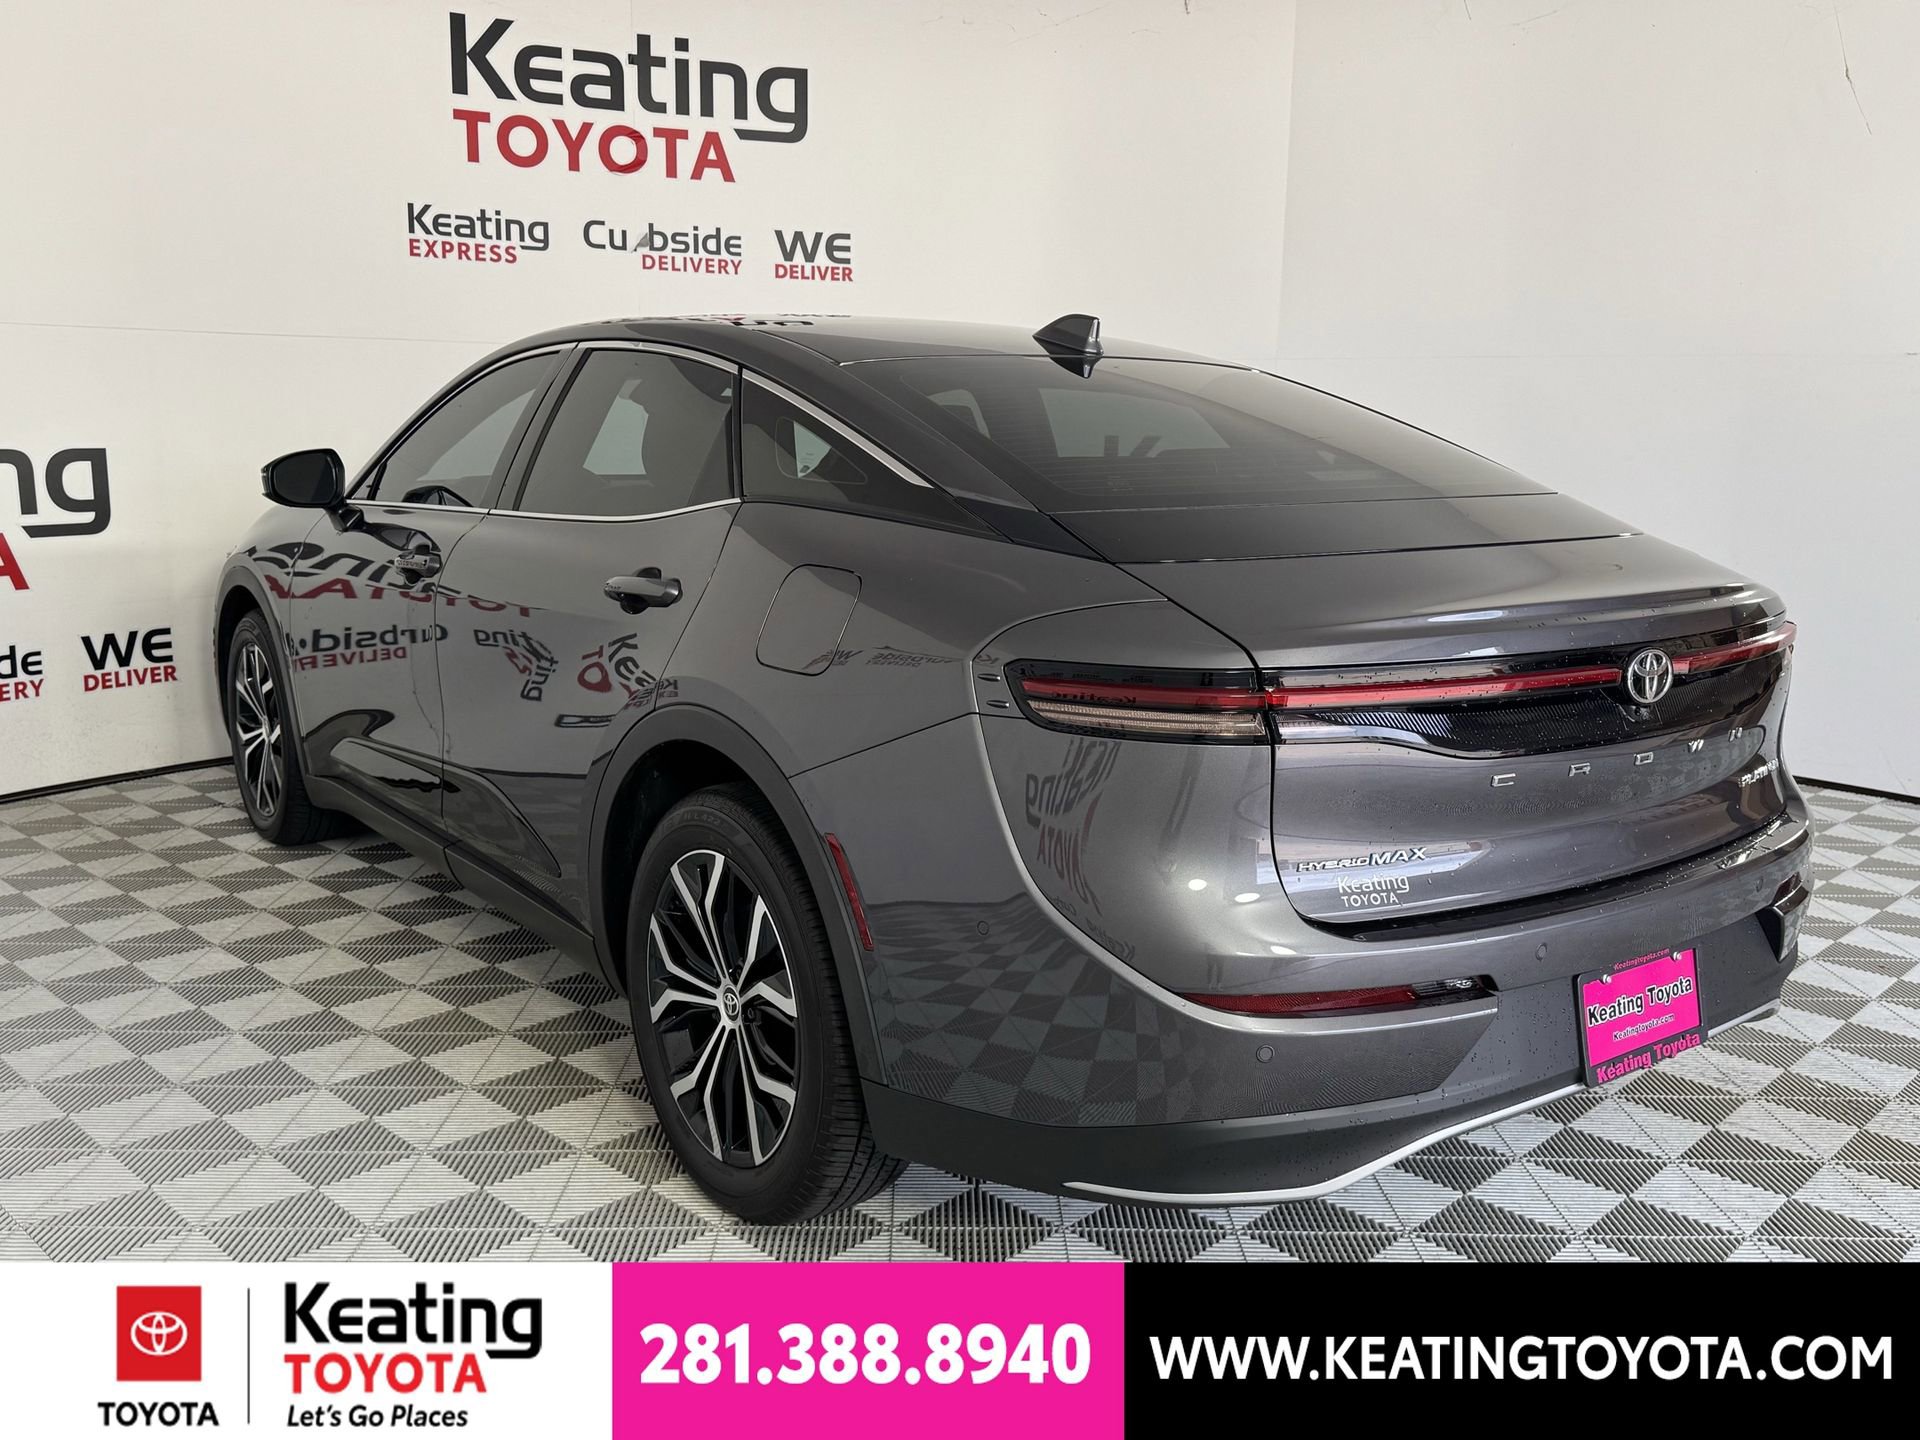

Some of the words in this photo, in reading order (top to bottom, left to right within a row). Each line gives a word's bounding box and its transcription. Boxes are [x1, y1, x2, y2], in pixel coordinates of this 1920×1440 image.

[449, 12, 808, 143] Keating
[453, 108, 735, 183] TOYOTA
[407, 202, 549, 251] Keating
[583, 219, 742, 257] Cubside
[409, 239, 518, 264] EXPRESS
[775, 229, 851, 264] WE
[642, 254, 742, 275] DELIVERY
[775, 264, 853, 282] DELIVER
[81, 627, 174, 670] WE
[83, 665, 177, 692] DELIVER
[1338, 873, 1410, 895] Keating
[1341, 892, 1399, 907] TOYOTA
[1588, 994, 1644, 1027] Keating
[1647, 976, 1693, 1006] Toyota
[1613, 1014, 1675, 1041] Keatingtoyota.com
[1596, 1051, 1652, 1084] Keating
[1654, 1033, 1701, 1060] Toyota
